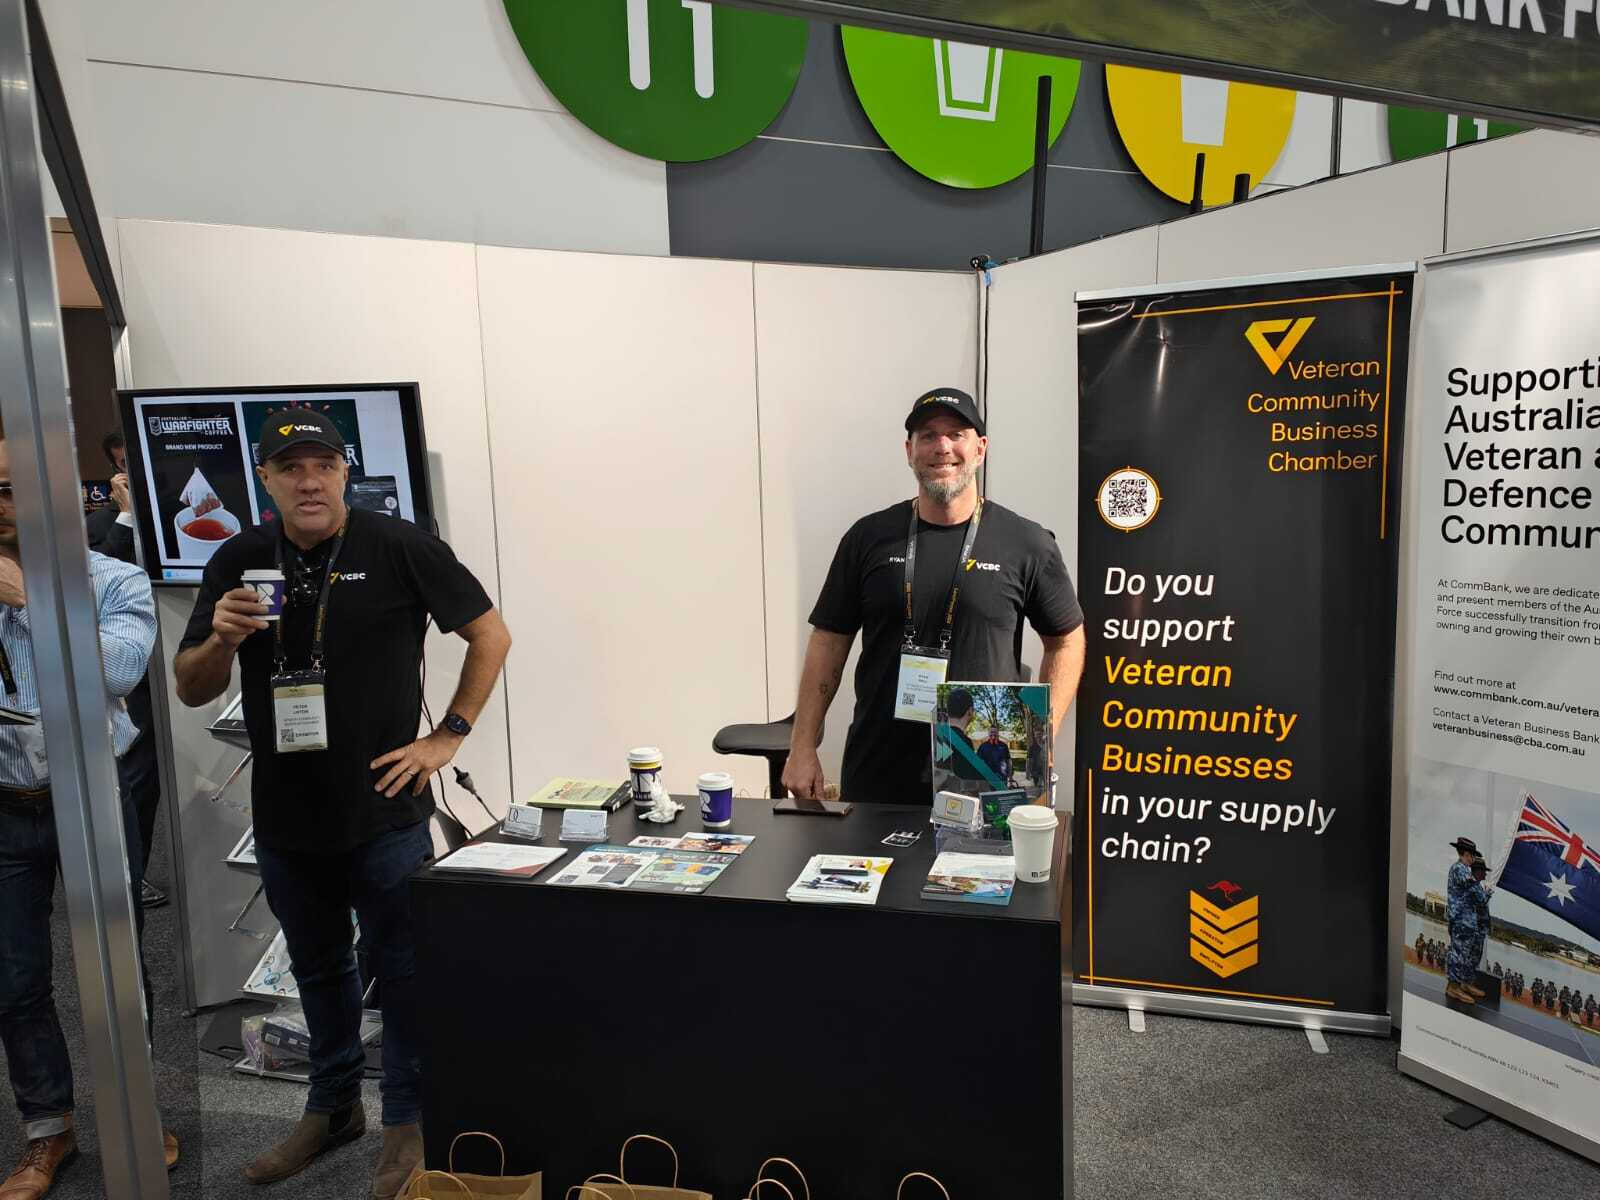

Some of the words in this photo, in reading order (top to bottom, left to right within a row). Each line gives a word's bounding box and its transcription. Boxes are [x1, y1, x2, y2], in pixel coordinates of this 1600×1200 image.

[1288, 359, 1380, 380] Veteran
[1247, 389, 1380, 414] Community
[161, 420, 234, 435] WARFIGHTER
[294, 424, 322, 433] VCBC
[1271, 421, 1378, 442] Business
[1268, 450, 1378, 473] Chamber
[1444, 441, 1582, 471] Veteran
[1443, 478, 1593, 509] Defence
[976, 562, 1001, 571] VCBC
[1103, 567, 1146, 596] Do
[1152, 574, 1216, 603] you
[1437, 578, 1448, 588] At
[1450, 579, 1512, 594] CommBank,
[1515, 585, 1530, 594] we
[1533, 586, 1550, 596] are
[1437, 593, 1454, 602] and
[1456, 595, 1494, 606] present
[1497, 598, 1547, 610] members
[1550, 601, 1561, 611] of
[1563, 602, 1582, 613] the
[1436, 606, 1463, 617] Force
[1464, 609, 1527, 624] successfully
[1529, 614, 1580, 628] transition
[1583, 619, 1600, 630] fro
[1103, 615, 1236, 648] support
[1436, 621, 1470, 633] owning
[1472, 624, 1492, 634] and
[1495, 626, 1538, 641] growing
[1540, 630, 1565, 641] their
[1567, 634, 1591, 644] own
[1103, 655, 1233, 688] Veteran
[1434, 670, 1454, 682] Find
[1456, 674, 1474, 684] out
[1476, 677, 1503, 688] more
[1505, 679, 1517, 690] at
[1102, 700, 1298, 742] Community
[1432, 706, 1471, 722] Contact
[1473, 714, 1480, 723] a
[1481, 714, 1521, 730] Veteran
[1524, 721, 1570, 739] Business
[1573, 730, 1600, 744] Bank
[1432, 721, 1586, 756] veteranbusiness@cba.com.au
[1102, 743, 1294, 781] Businesses
[1101, 786, 1129, 816] in
[1136, 796, 1213, 824] your
[1219, 799, 1337, 835] supply
[1101, 831, 1212, 864] chain?
